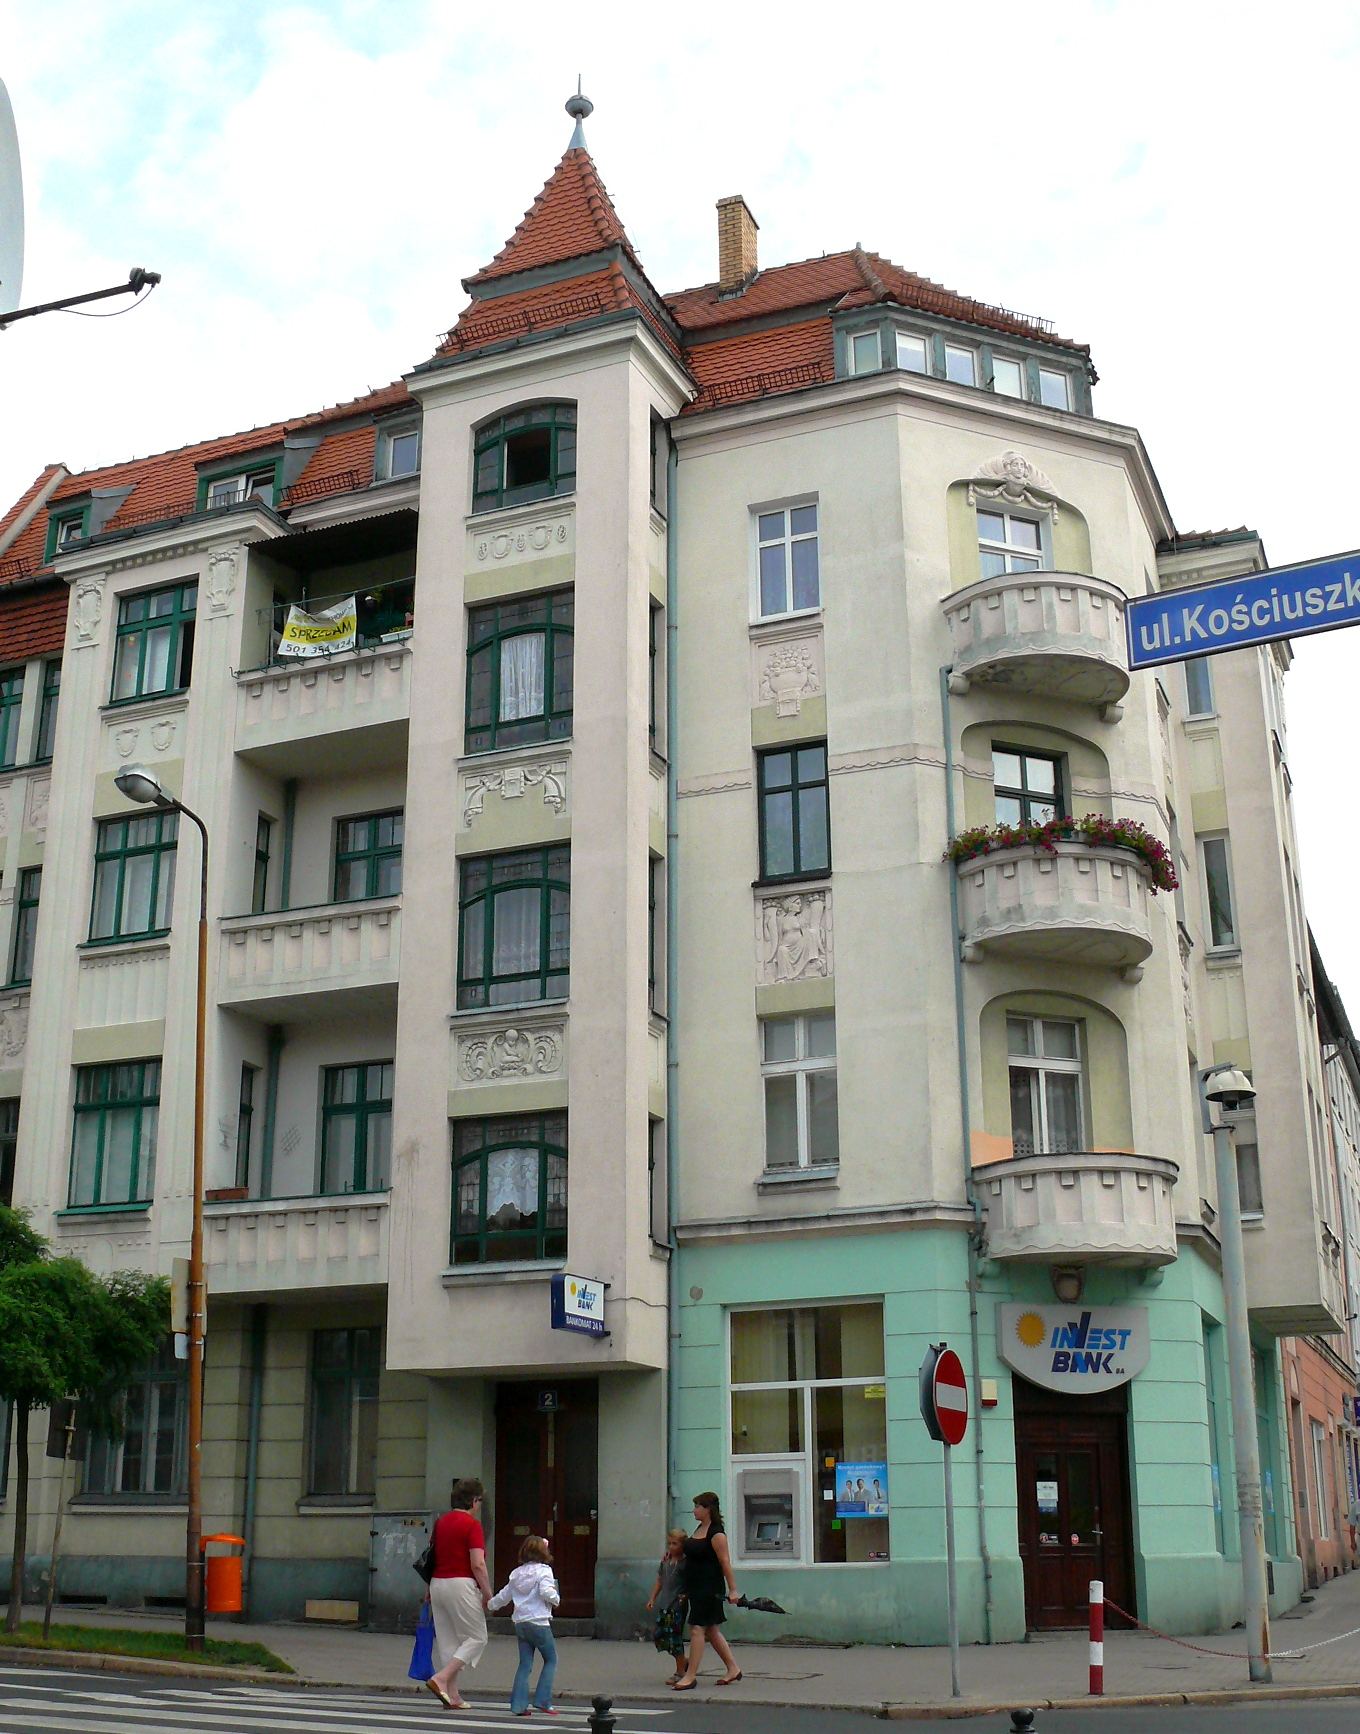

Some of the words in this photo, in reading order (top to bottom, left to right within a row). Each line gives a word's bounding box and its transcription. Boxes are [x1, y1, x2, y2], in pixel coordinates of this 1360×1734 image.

[577, 1284, 597, 1301] INVEST
[578, 1299, 594, 1311] BANK
[566, 1315, 592, 1329] BANKOMAT
[592, 1320, 599, 1330] 24
[1050, 1311, 1132, 1350] INVEST
[1051, 1351, 1115, 1374] BANK
[544, 1393, 553, 1406] 2
